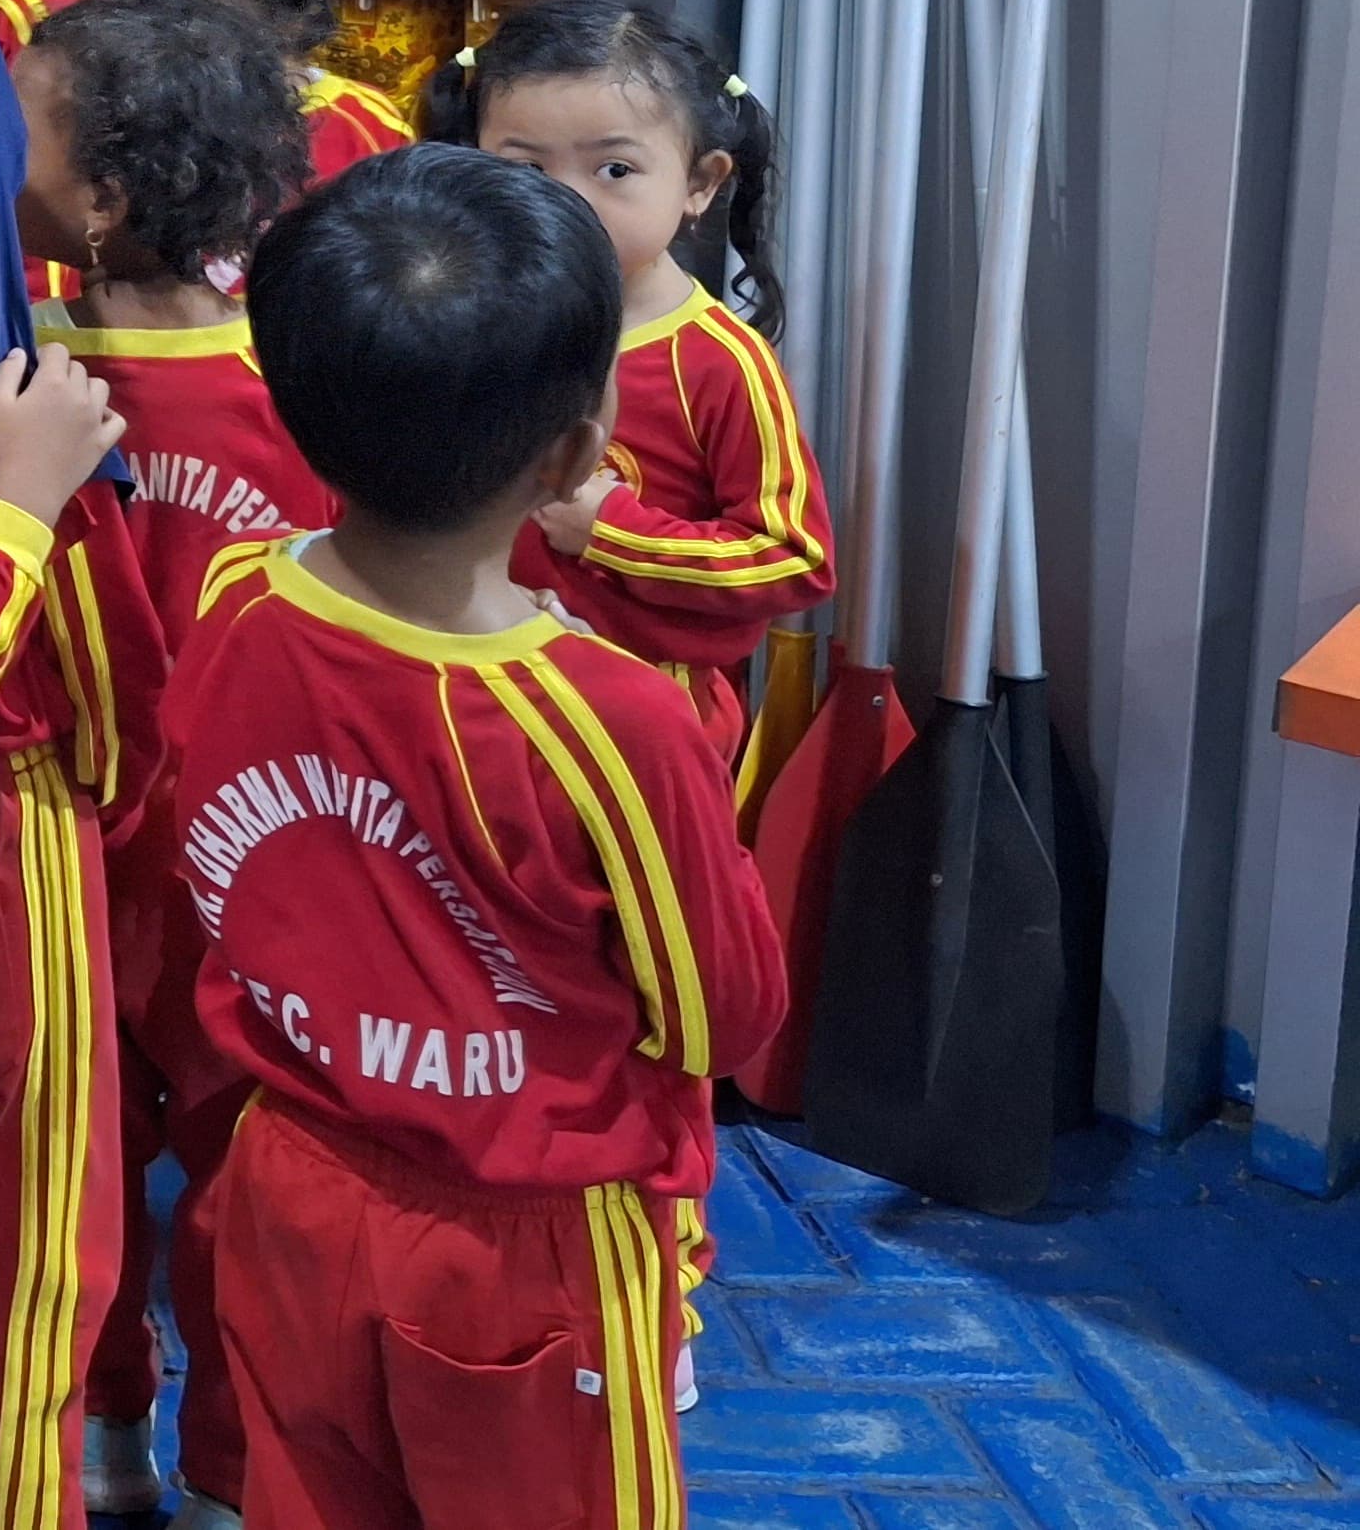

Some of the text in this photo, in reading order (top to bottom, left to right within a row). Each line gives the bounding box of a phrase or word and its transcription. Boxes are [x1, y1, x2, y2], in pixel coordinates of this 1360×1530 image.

[129, 451, 218, 516] ANITA
[184, 759, 308, 890] DHARMA
[358, 1012, 525, 1098] WARU
